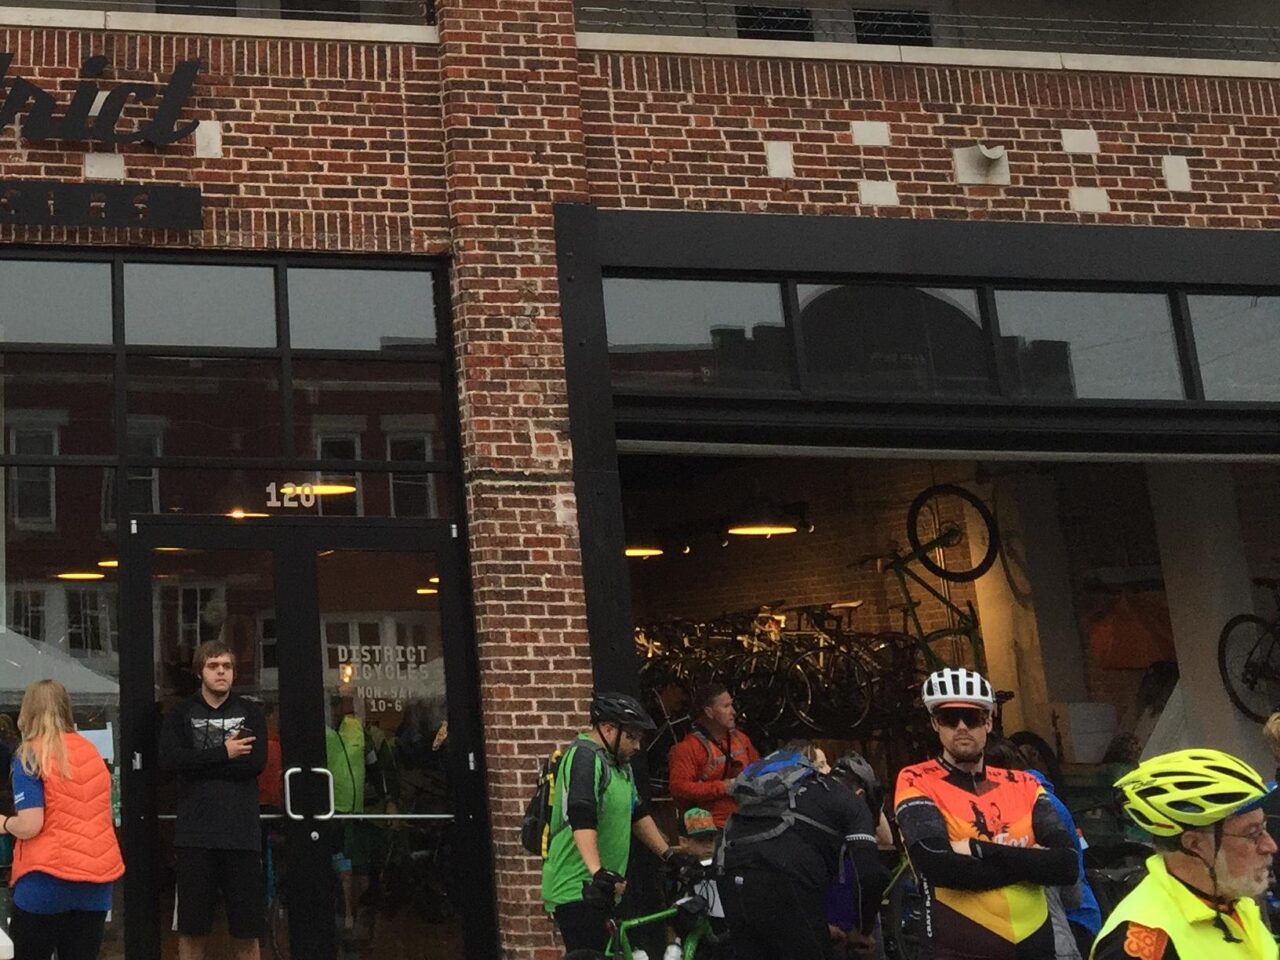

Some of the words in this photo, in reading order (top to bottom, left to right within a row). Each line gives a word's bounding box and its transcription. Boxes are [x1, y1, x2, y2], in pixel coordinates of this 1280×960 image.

[266, 482, 316, 508] 120
[337, 645, 428, 662] DISTRICT
[370, 700, 402, 713] 10-6
